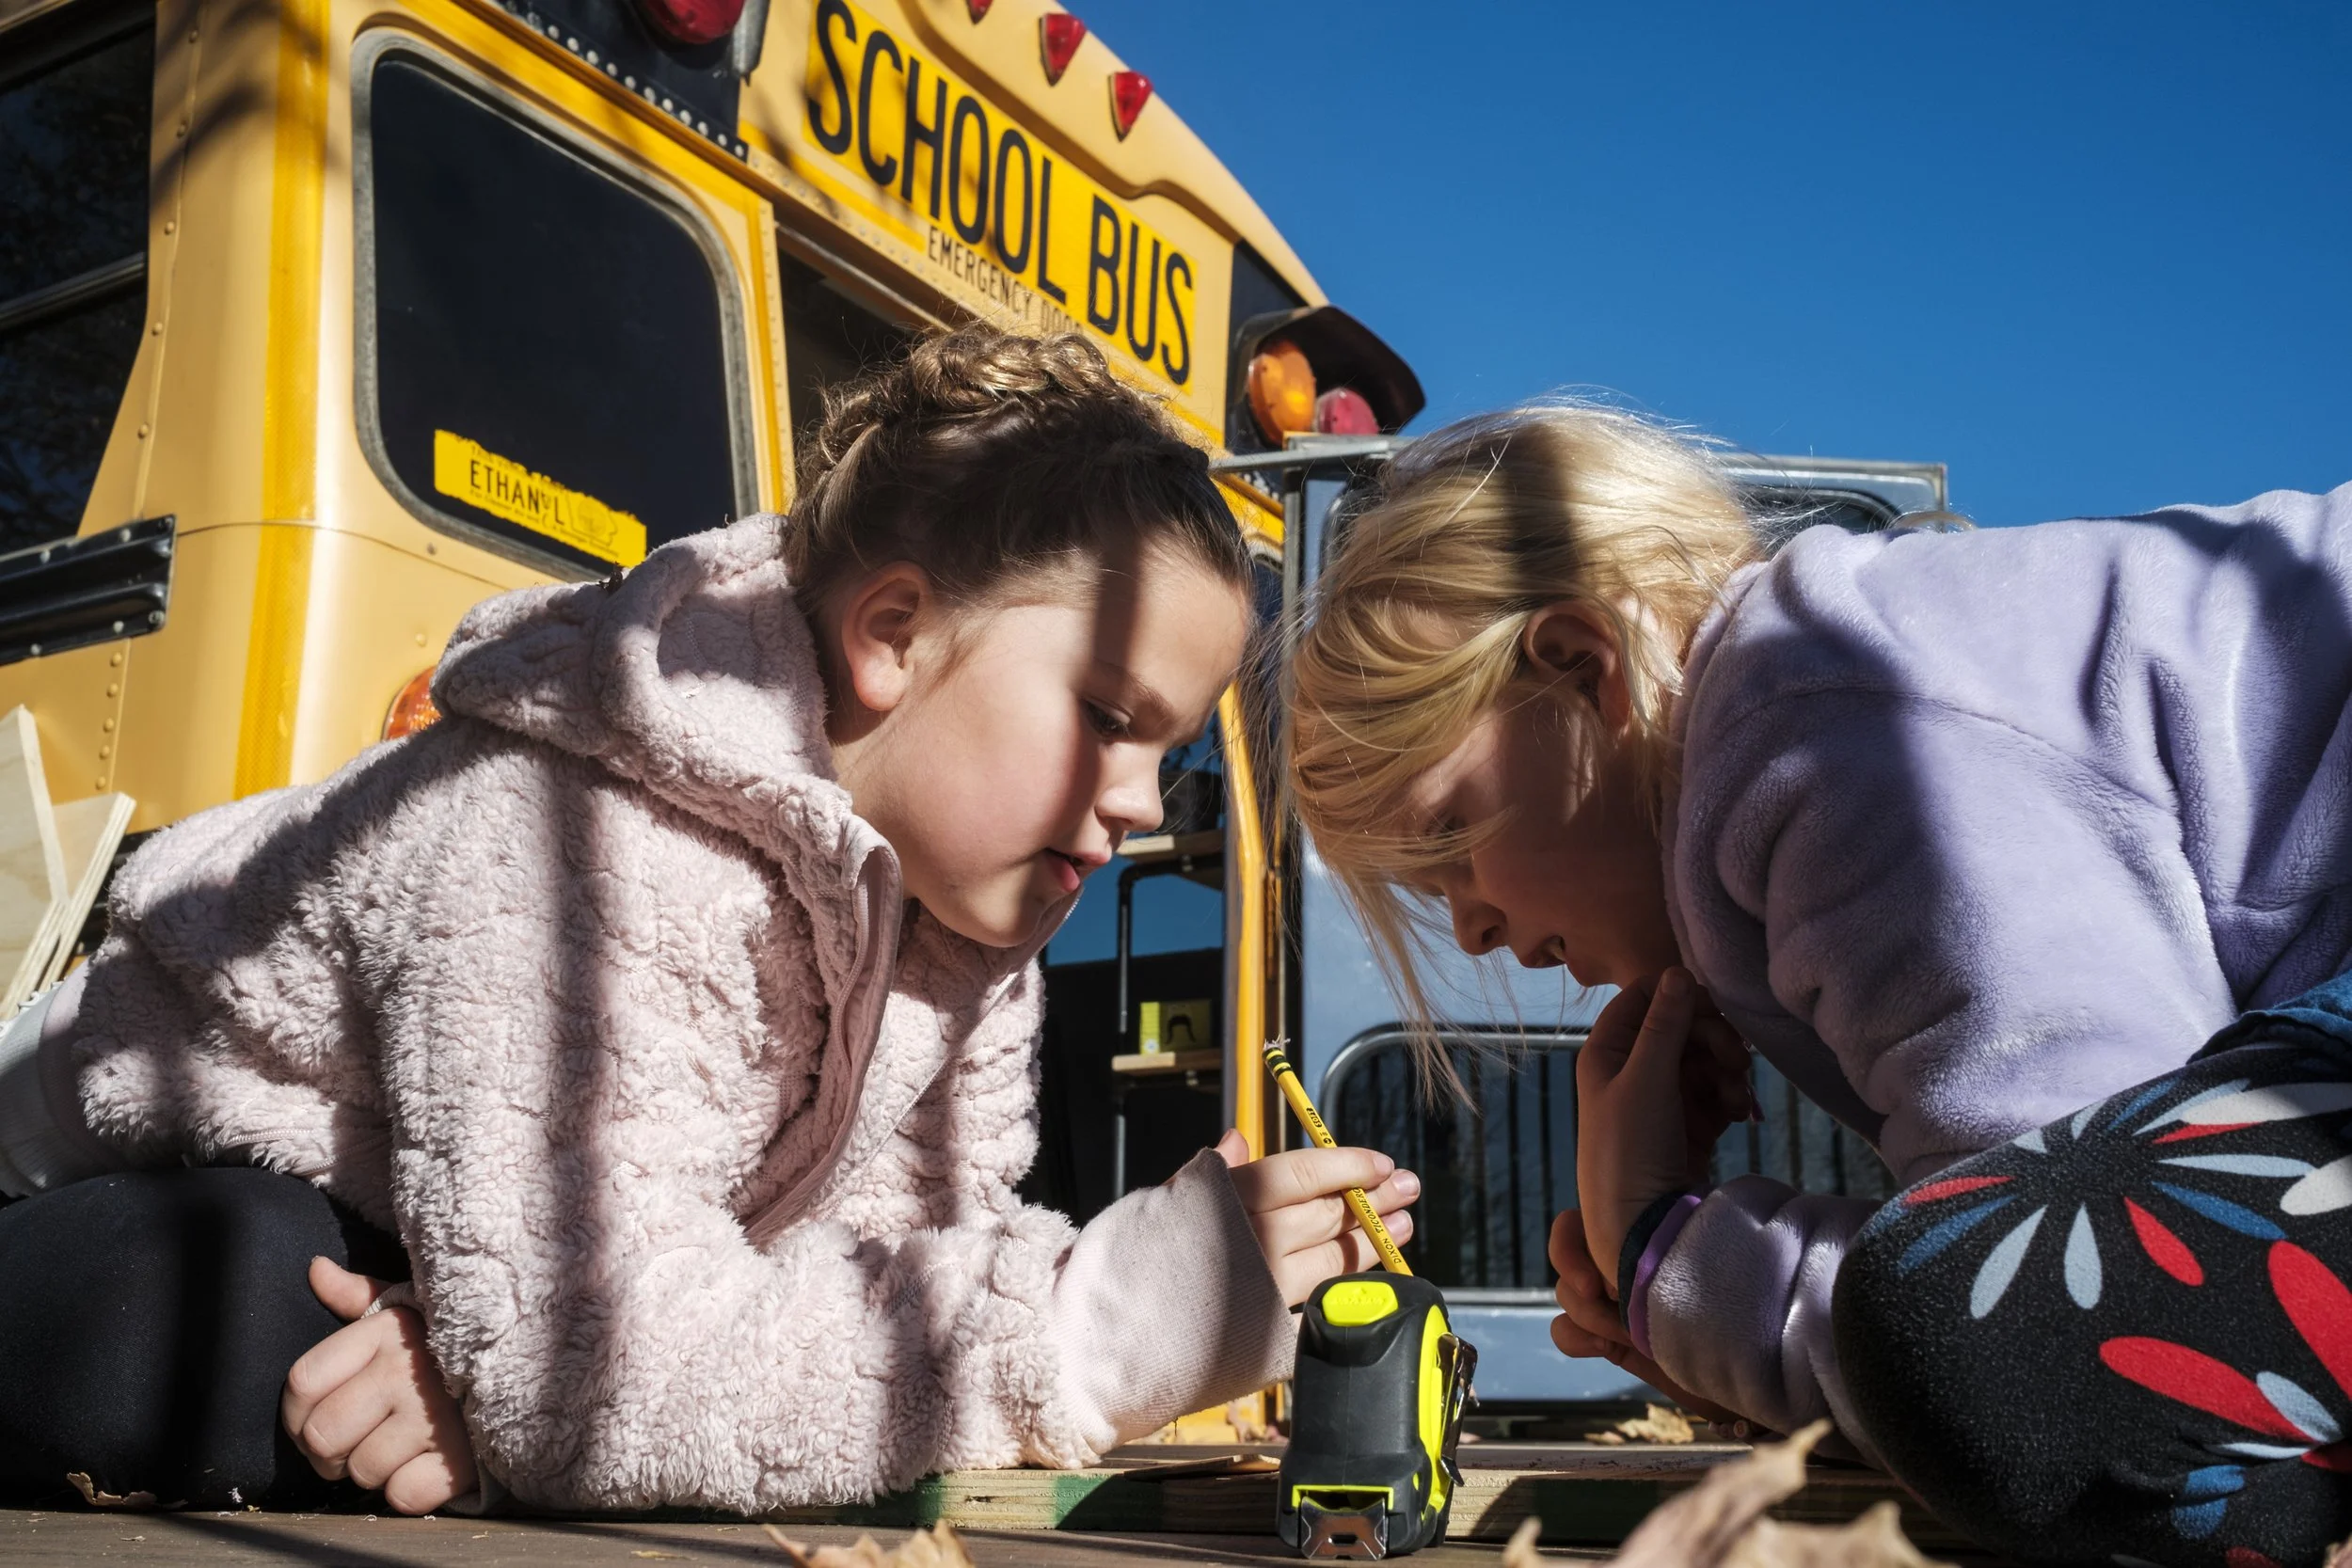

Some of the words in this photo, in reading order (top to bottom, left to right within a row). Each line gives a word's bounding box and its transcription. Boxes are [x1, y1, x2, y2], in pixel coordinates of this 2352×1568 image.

[806, 0, 1067, 306] SCHOOL
[1089, 193, 1194, 386] BUS
[929, 225, 1033, 320] EMERGENCY
[1382, 1238, 1402, 1264] DIXON
